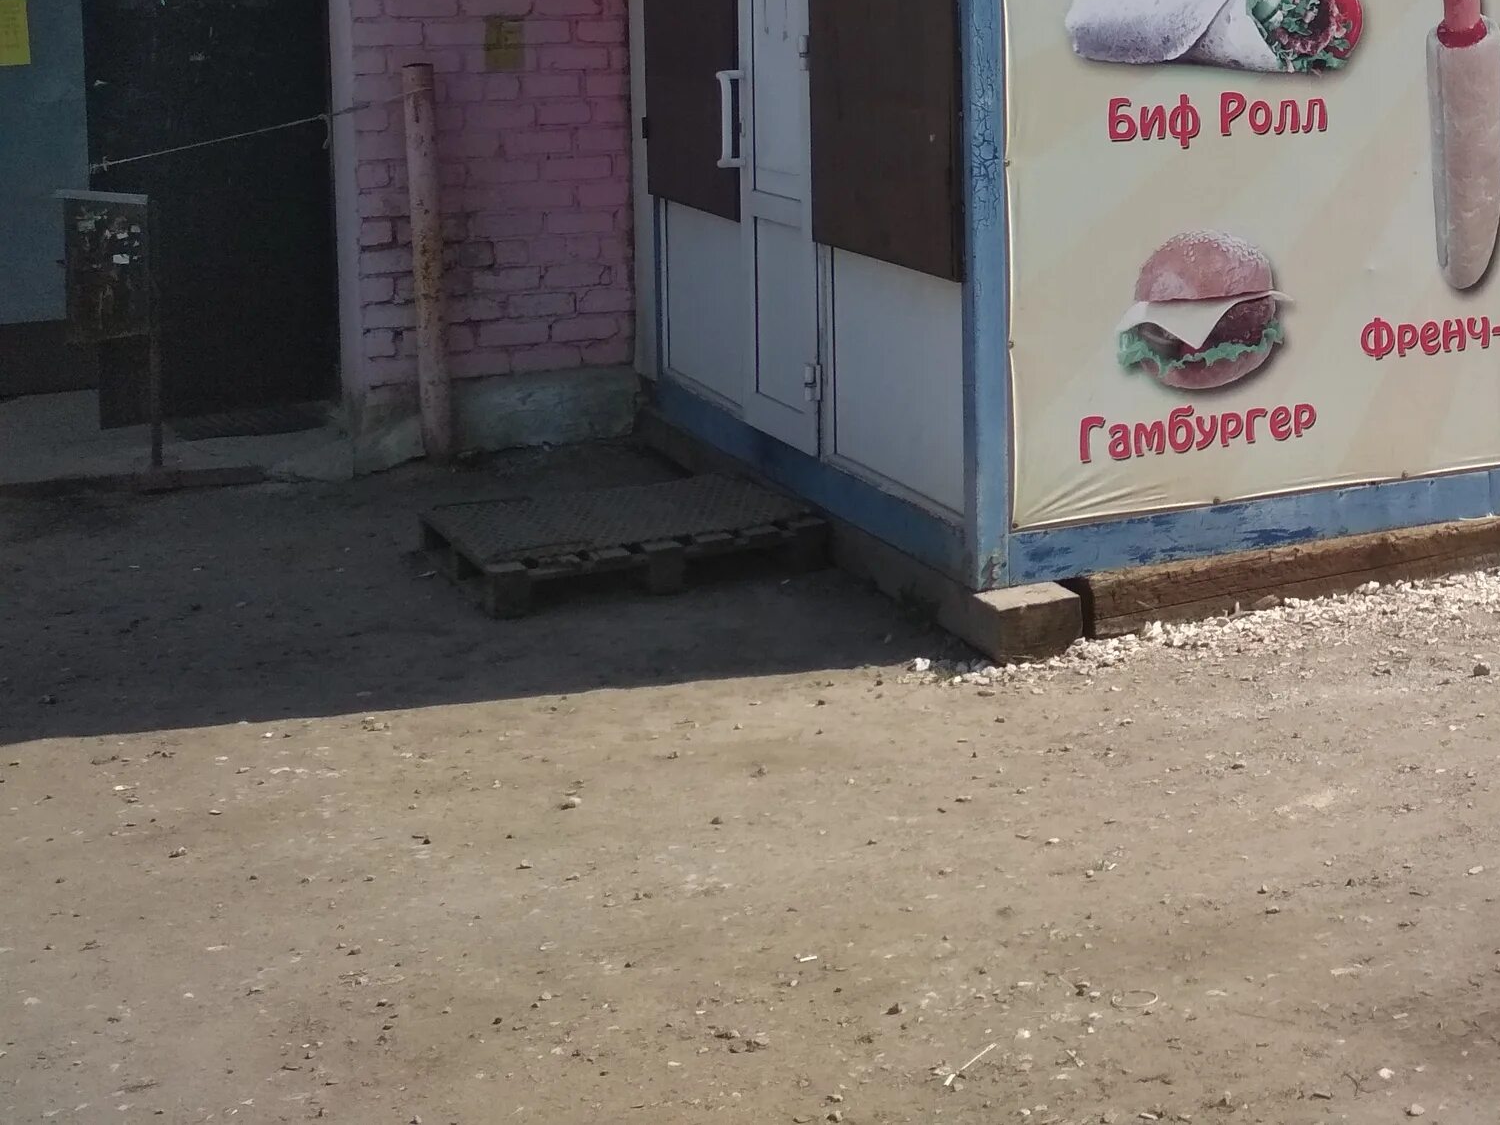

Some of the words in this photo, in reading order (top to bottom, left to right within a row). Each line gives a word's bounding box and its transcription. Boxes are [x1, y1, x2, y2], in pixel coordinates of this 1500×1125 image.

[1107, 94, 1201, 150] Биф
[1219, 91, 1328, 136] Ролл
[1079, 403, 1317, 463] Гамбургер
